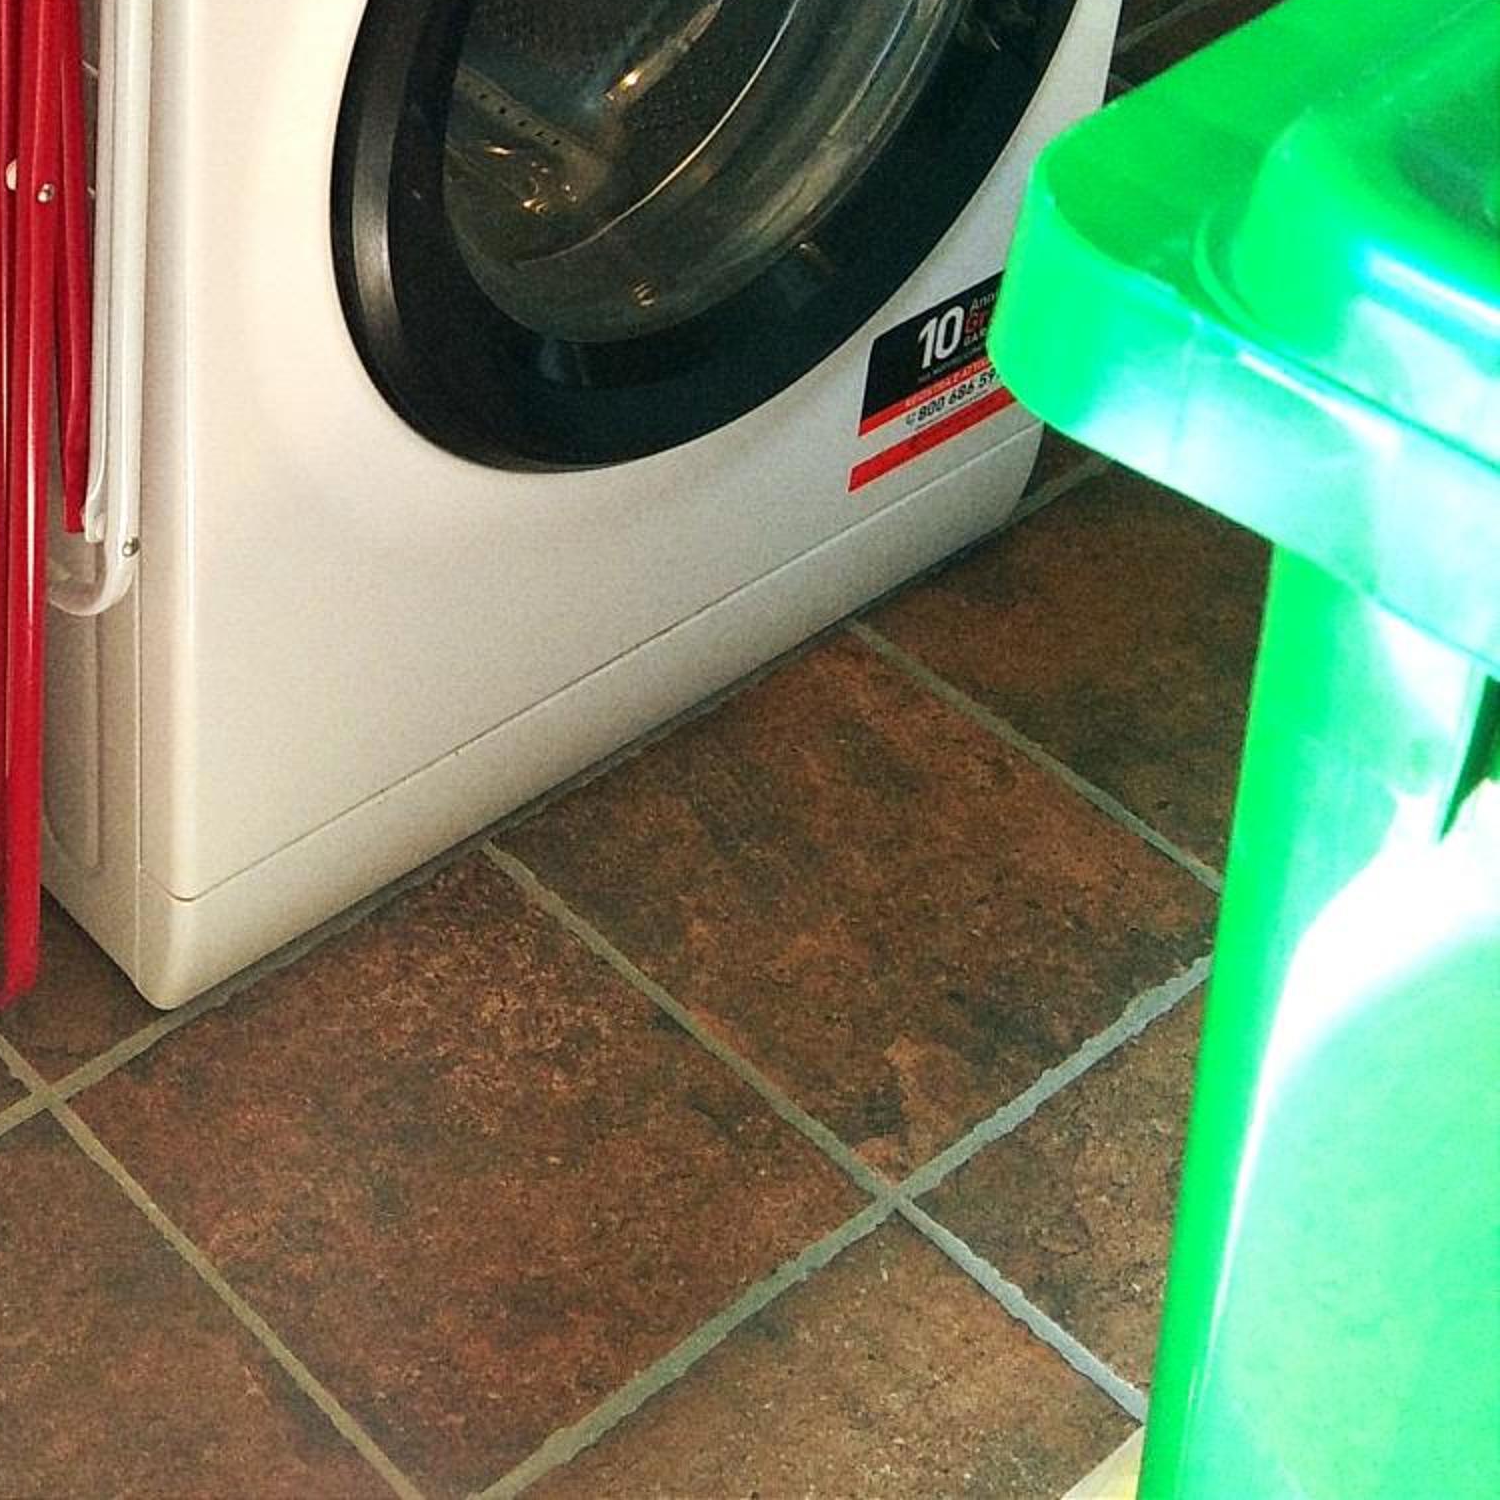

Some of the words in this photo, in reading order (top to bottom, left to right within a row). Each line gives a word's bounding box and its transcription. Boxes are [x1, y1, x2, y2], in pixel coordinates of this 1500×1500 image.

[918, 305, 965, 369] 10
[917, 396, 945, 421] 800
[948, 381, 975, 404] 686
